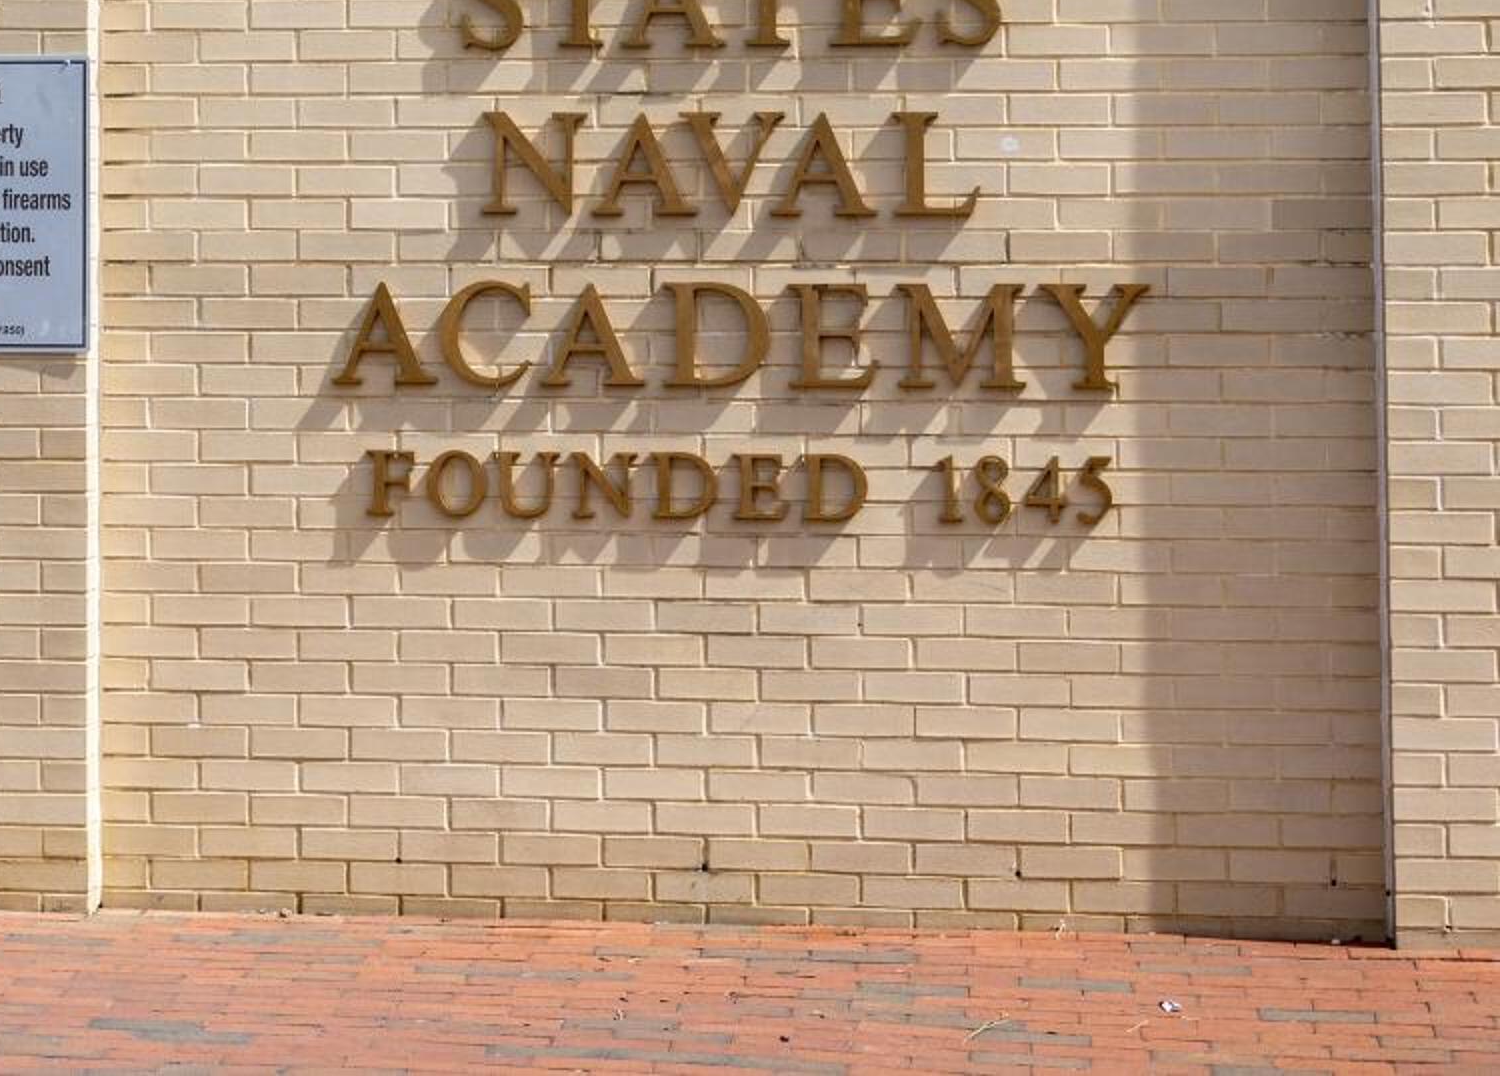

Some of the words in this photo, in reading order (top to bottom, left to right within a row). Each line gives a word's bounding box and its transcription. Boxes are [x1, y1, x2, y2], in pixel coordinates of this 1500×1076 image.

[0, 156, 14, 177] in
[20, 160, 48, 177] use
[3, 190, 71, 210] firearms
[480, 111, 980, 218] NAVAL
[332, 280, 1150, 390] ACADEMY
[367, 450, 868, 523] FOUNDED
[939, 450, 1114, 523] 1845
